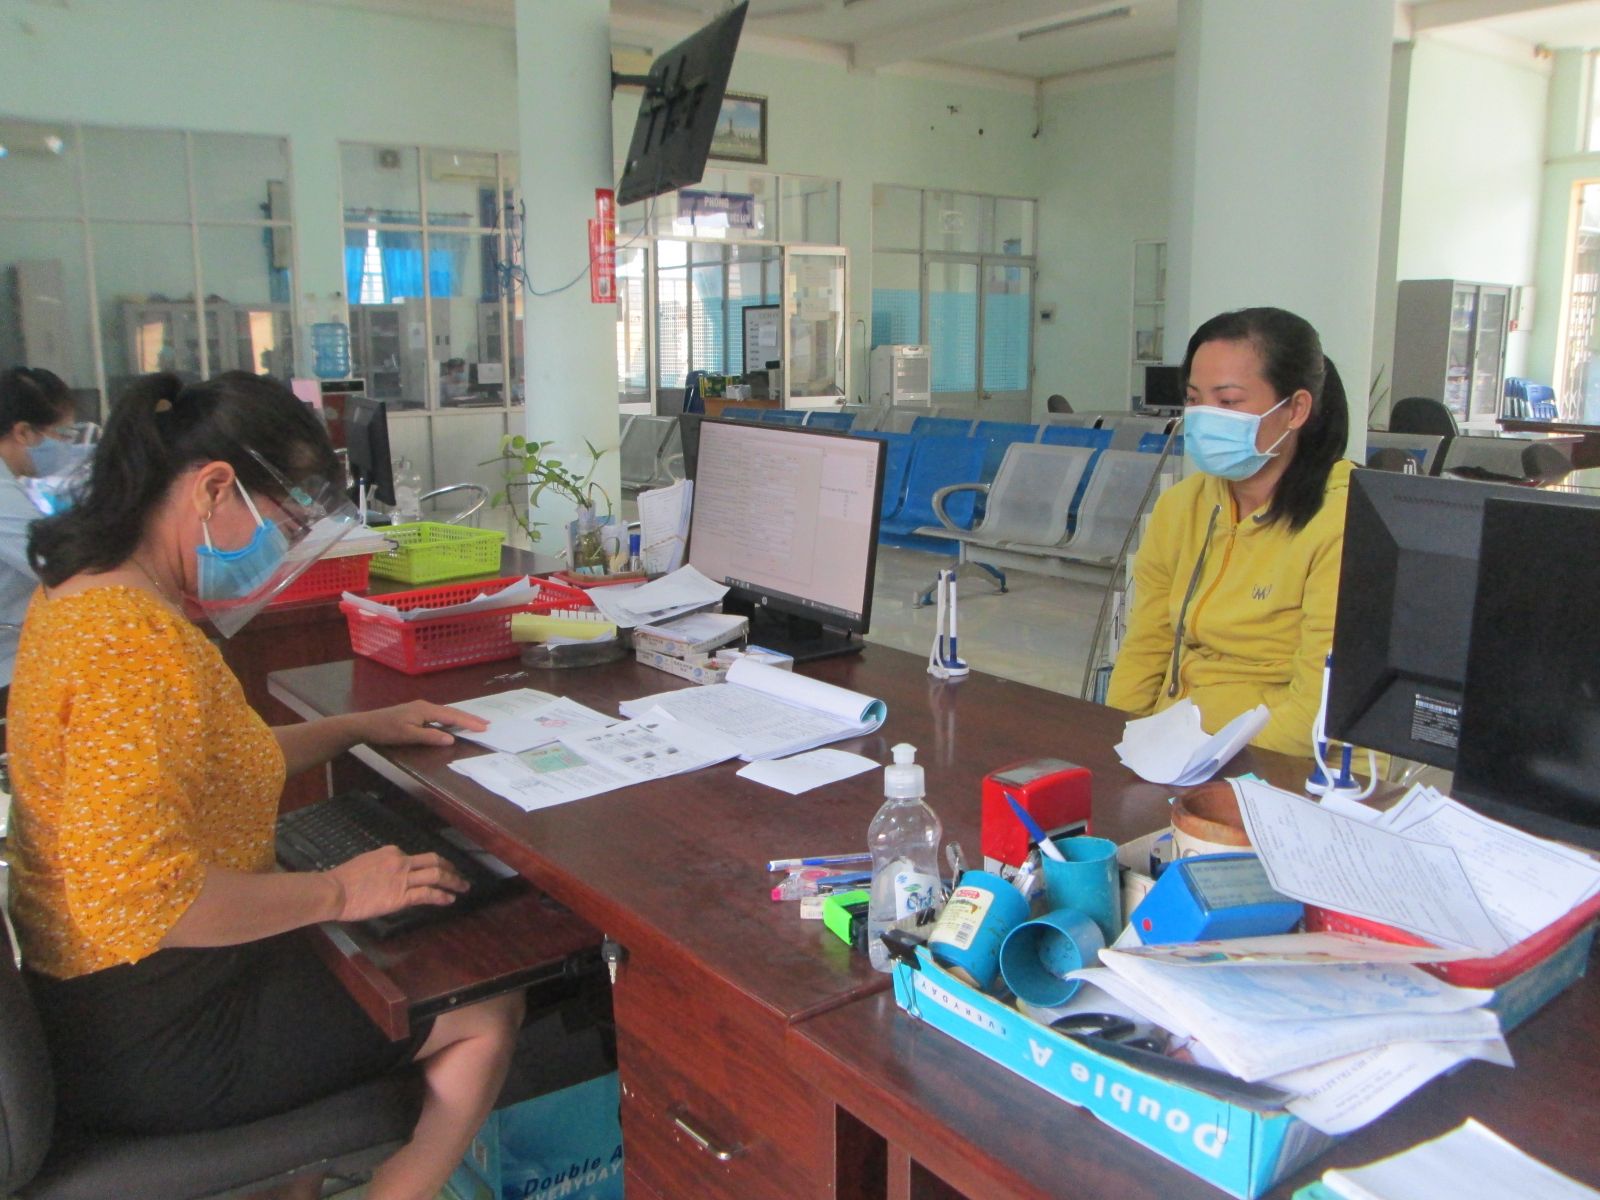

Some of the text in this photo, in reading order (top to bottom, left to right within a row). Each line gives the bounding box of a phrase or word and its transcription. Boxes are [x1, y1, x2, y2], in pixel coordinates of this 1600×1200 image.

[920, 980, 1007, 1036] EVERYDAY
[1028, 1038, 1053, 1068] A
[1070, 1061, 1229, 1159] Double
[524, 1144, 623, 1196] Double A
